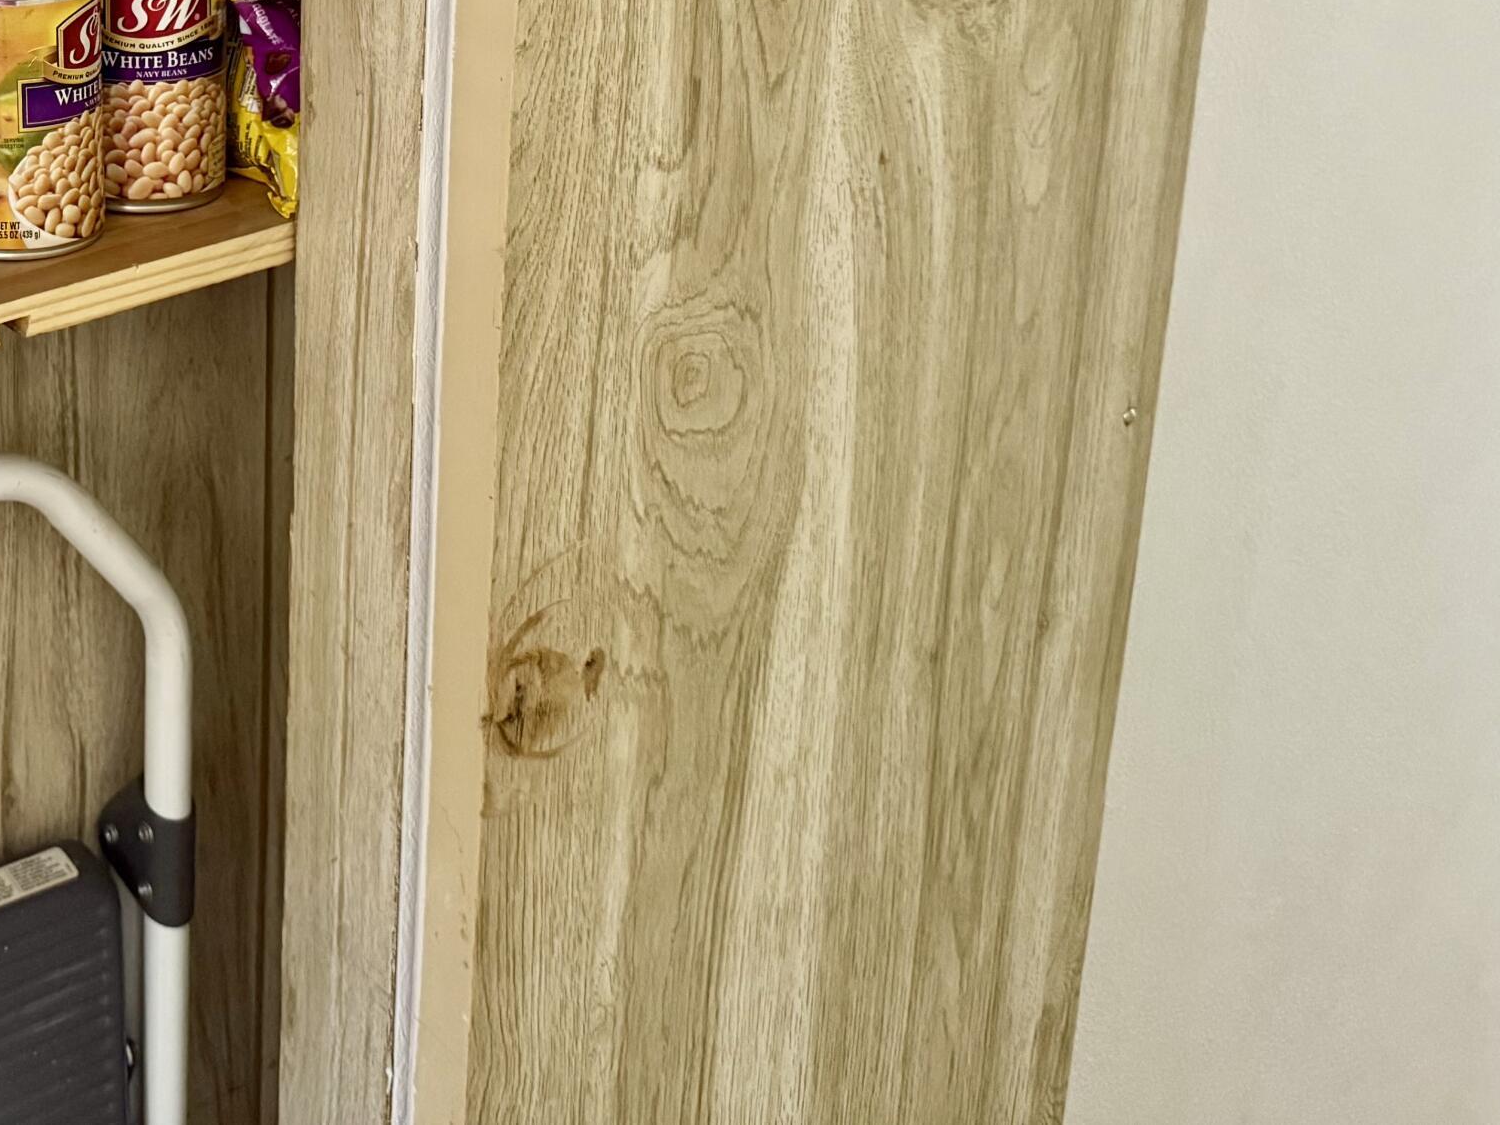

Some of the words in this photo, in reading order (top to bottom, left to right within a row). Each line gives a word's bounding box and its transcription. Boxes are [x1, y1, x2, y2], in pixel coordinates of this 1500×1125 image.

[138, 38, 175, 50] QUALITY
[176, 30, 200, 44] SINCE
[100, 50, 163, 71] WHITE
[166, 47, 214, 68] BEANS
[135, 69, 160, 79] NAVY
[161, 68, 188, 77] BEANS
[54, 82, 99, 106] WHITE
[11, 222, 21, 231] WT
[9, 230, 19, 239] OZ
